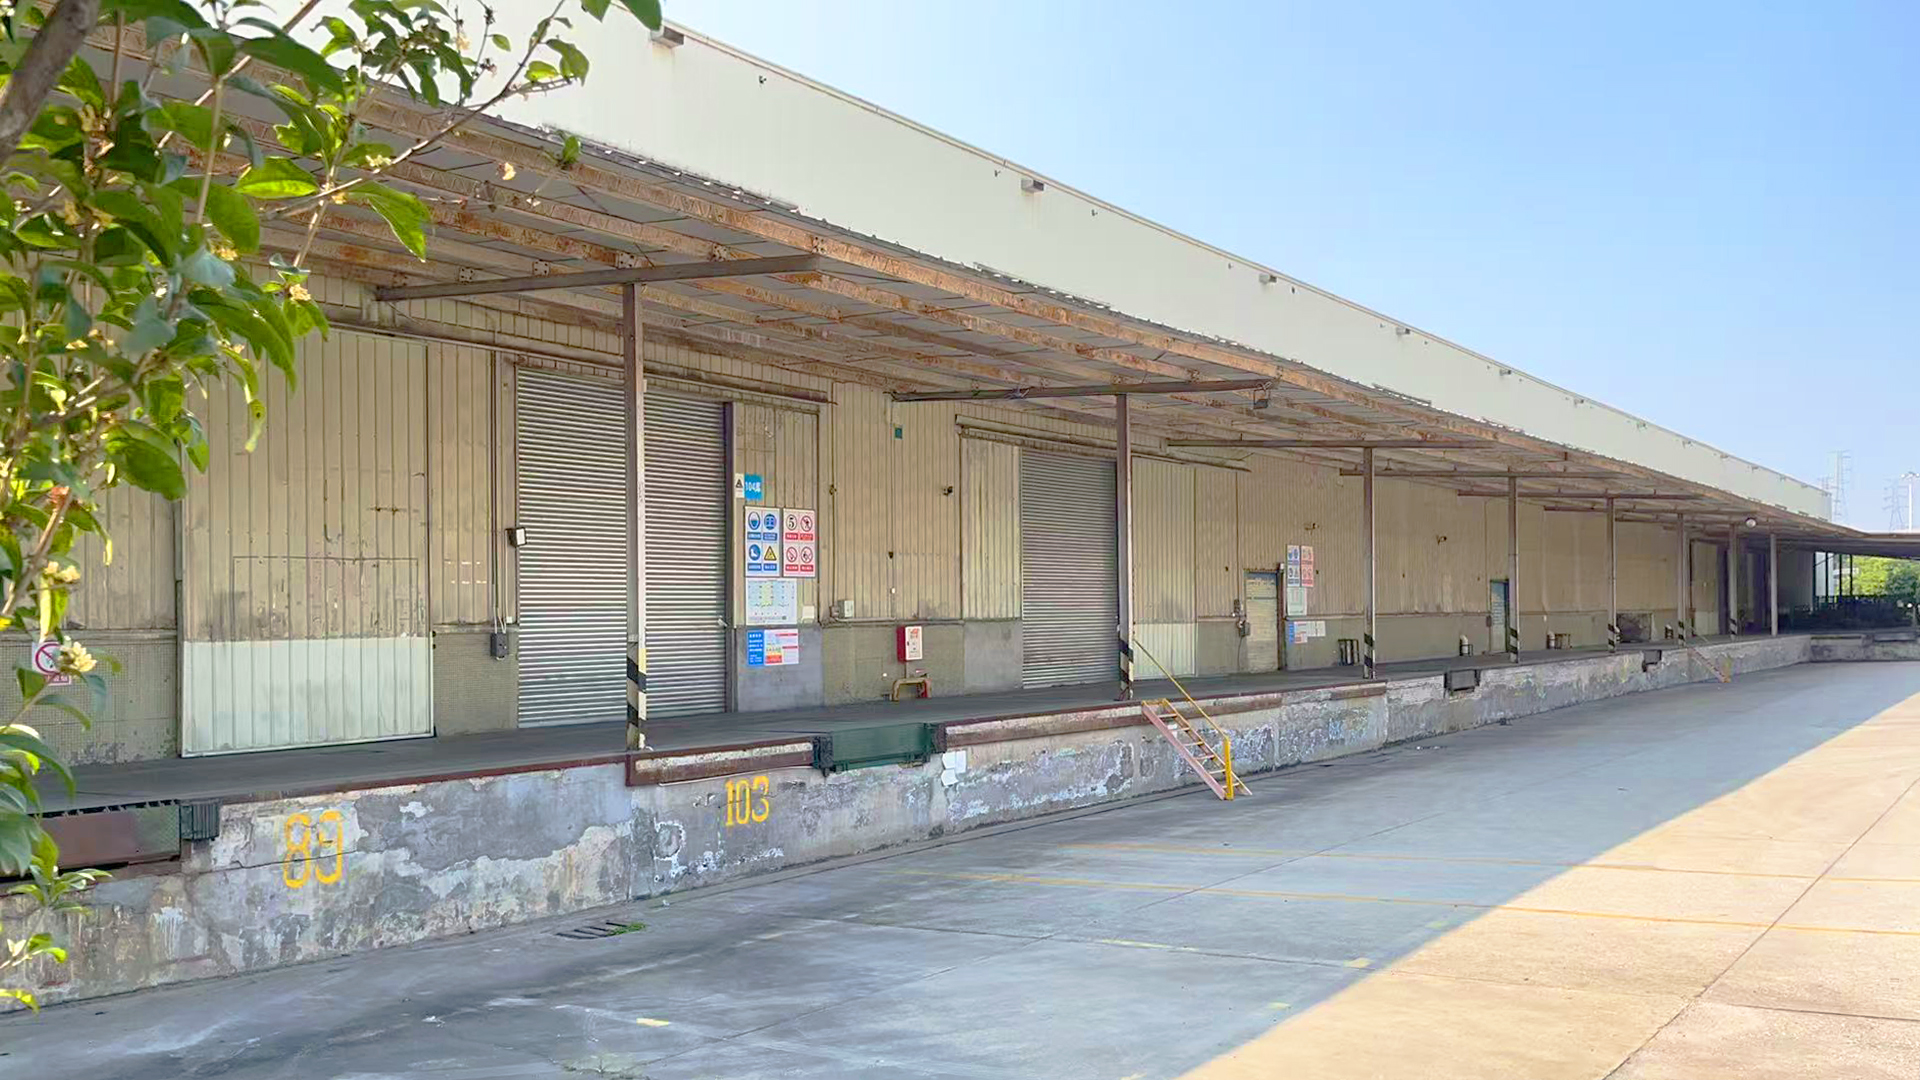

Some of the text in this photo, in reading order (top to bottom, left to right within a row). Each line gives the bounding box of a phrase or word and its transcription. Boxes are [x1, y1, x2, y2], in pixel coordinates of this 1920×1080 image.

[788, 516, 796, 529] 5
[725, 775, 769, 827] 103
[283, 810, 344, 888] 89
